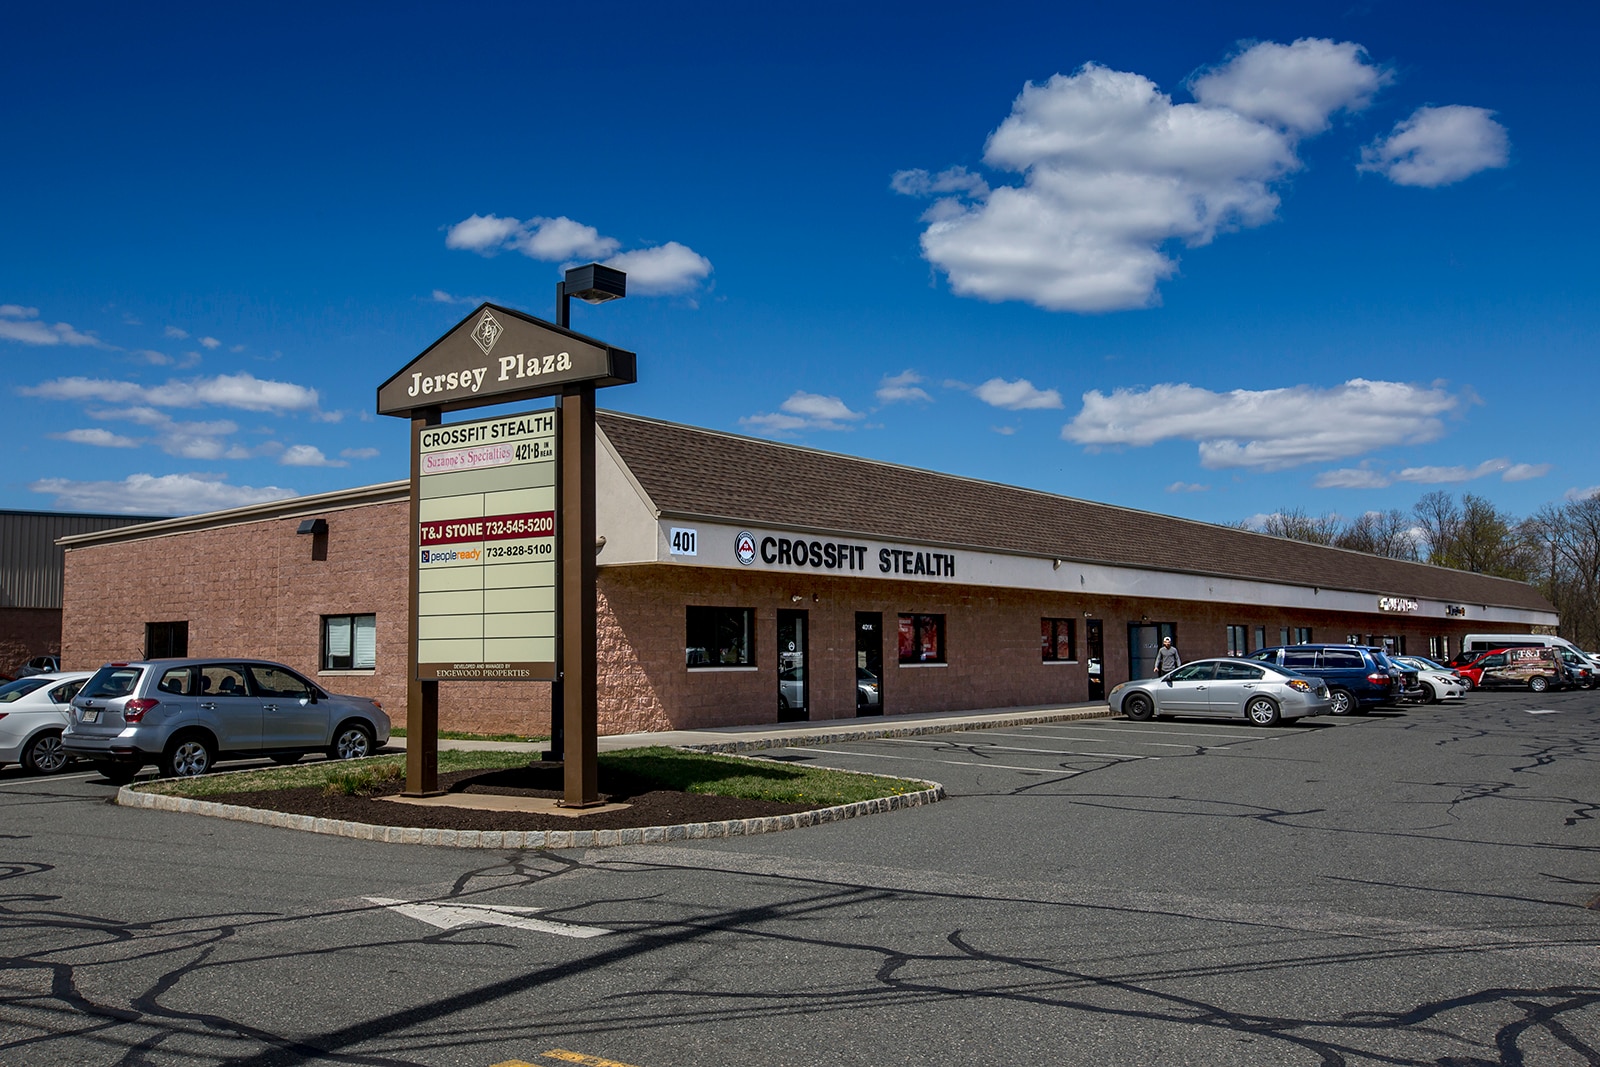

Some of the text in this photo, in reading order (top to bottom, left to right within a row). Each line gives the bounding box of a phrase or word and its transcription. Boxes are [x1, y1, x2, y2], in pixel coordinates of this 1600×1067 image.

[408, 351, 572, 396] Jersey Plaza
[423, 416, 553, 447] CROSSFIT STEALTH
[427, 448, 511, 468] Suzanne's Specialties
[422, 517, 553, 540] T&J STONE 732-545-5200
[486, 543, 552, 558] 732-828-5100
[673, 531, 696, 553] 401
[431, 549, 481, 563] peopleready
[760, 536, 956, 577] CROSSFIT STEALTH
[436, 669, 530, 677] EDGEWOOD PROPERTIES
